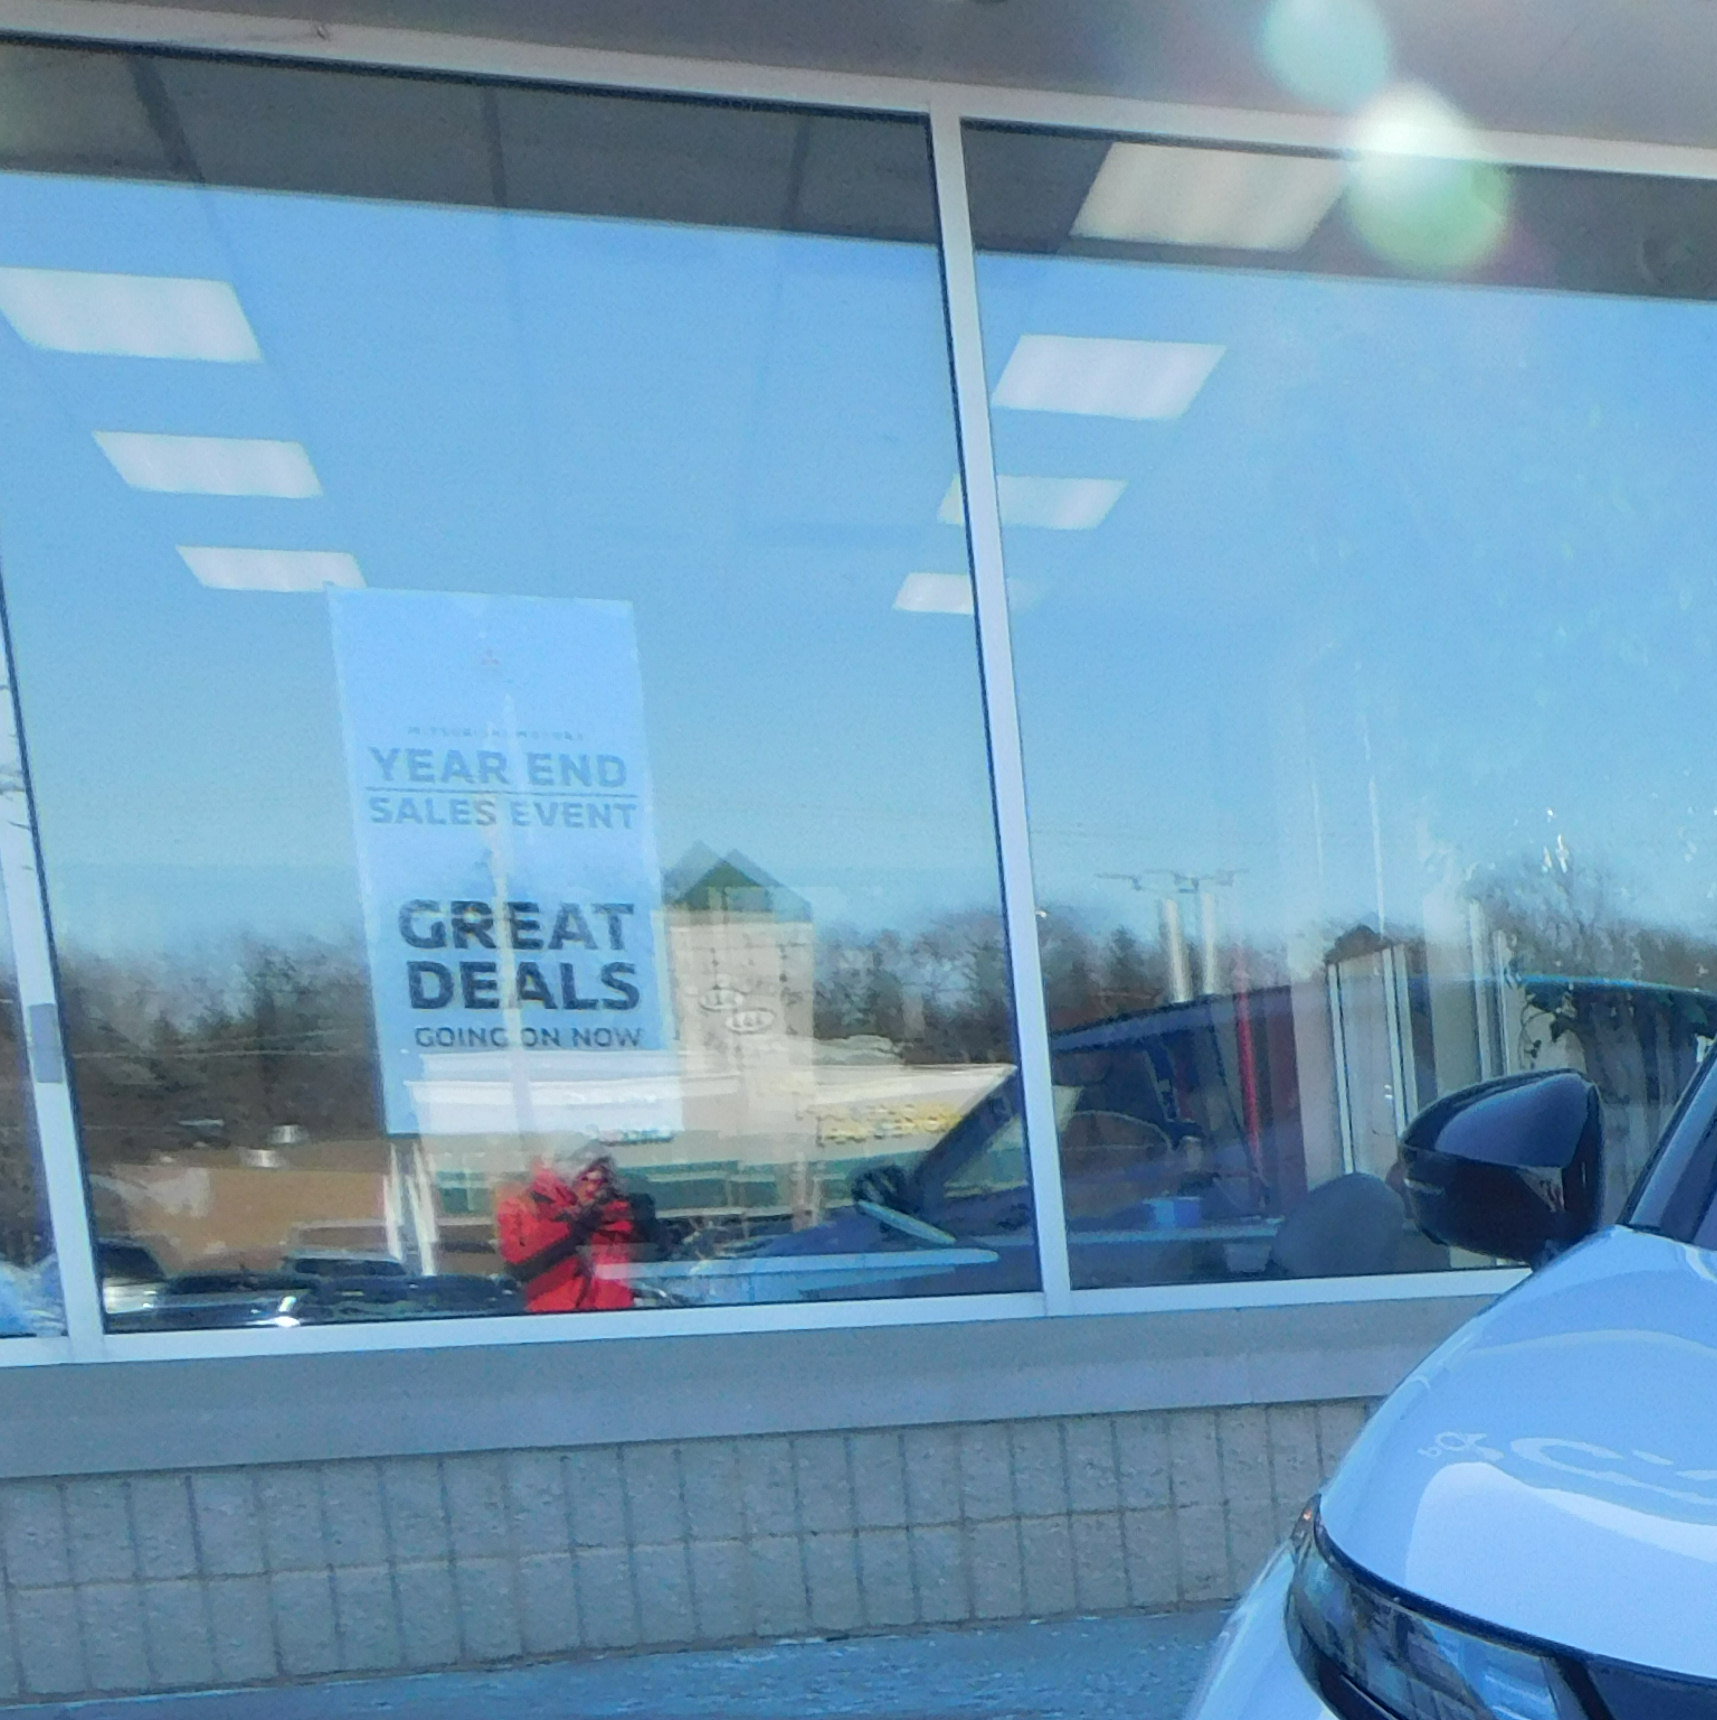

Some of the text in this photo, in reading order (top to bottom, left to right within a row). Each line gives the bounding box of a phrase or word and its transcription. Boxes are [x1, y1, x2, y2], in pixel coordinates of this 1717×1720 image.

[368, 746, 627, 787] YEAR END
[368, 797, 637, 829] SALES EVENT
[399, 899, 634, 950] GREAT
[406, 960, 640, 1010] DEALS
[415, 1026, 644, 1048] GOING ON NOW
